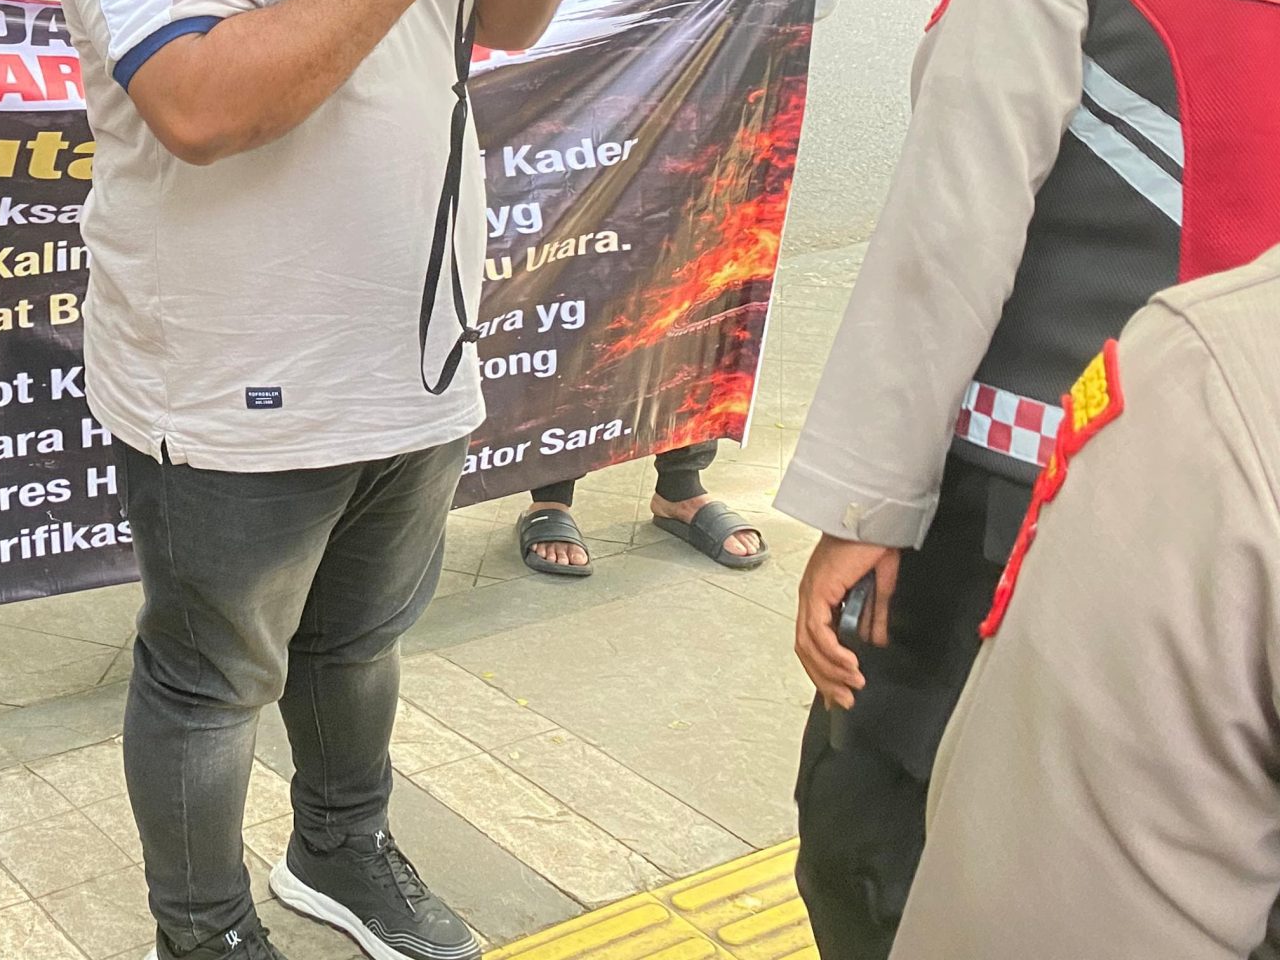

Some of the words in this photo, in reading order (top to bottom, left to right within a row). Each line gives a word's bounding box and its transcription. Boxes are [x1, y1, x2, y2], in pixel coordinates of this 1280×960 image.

[502, 136, 639, 178] Kader
[486, 201, 544, 239] yg
[525, 229, 632, 273] Utara.
[535, 299, 586, 333] yg
[539, 417, 633, 456] Sara.
